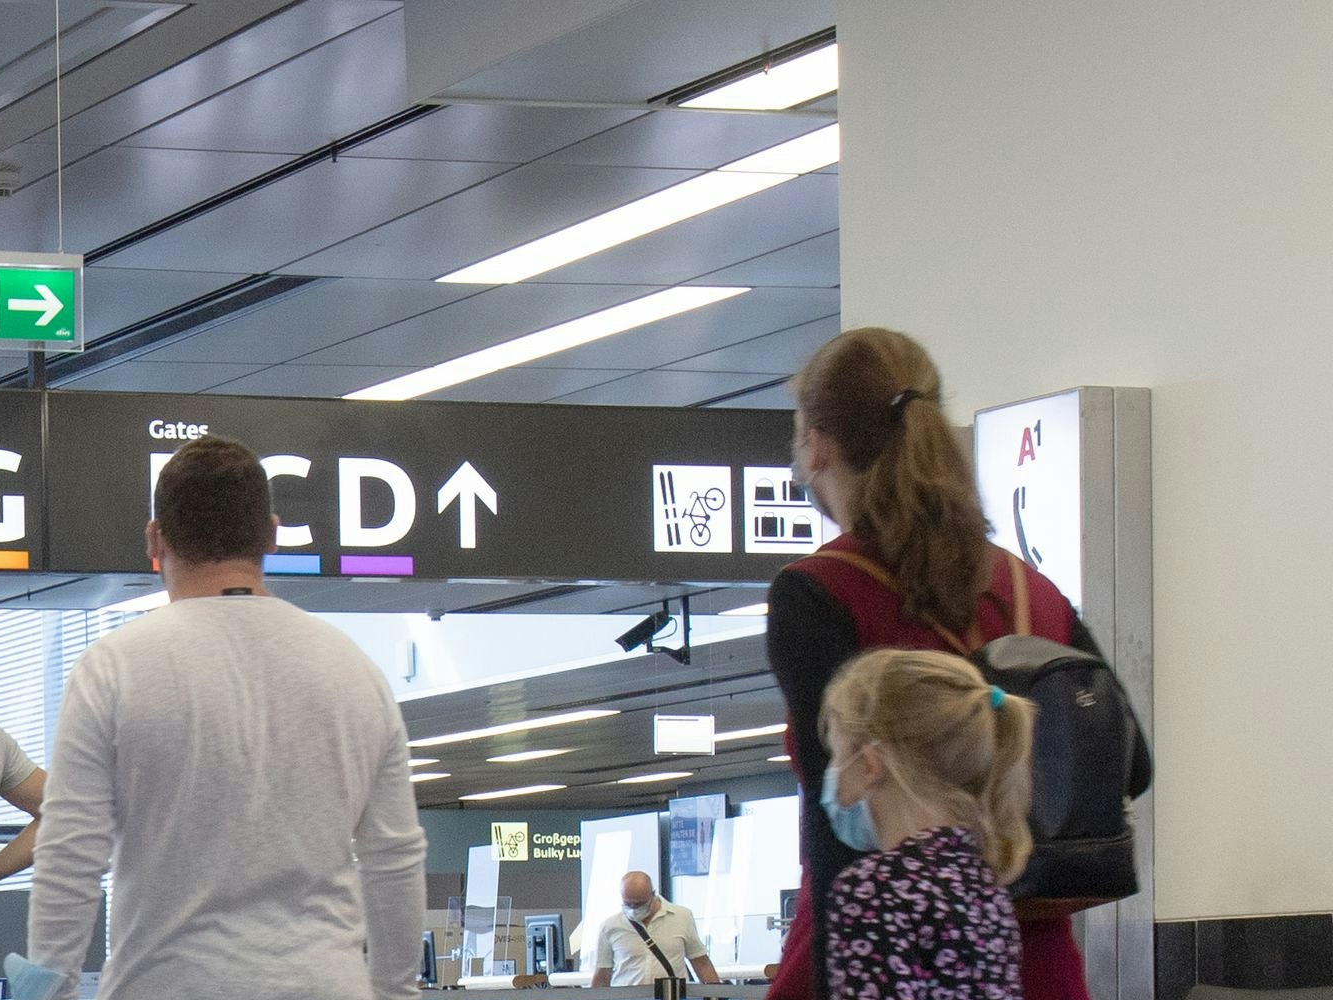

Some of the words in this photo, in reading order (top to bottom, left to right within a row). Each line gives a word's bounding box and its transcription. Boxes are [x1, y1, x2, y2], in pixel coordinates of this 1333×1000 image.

[148, 420, 209, 440] Gates
[533, 832, 581, 847] Großgep
[533, 848, 564, 861] Bulky
